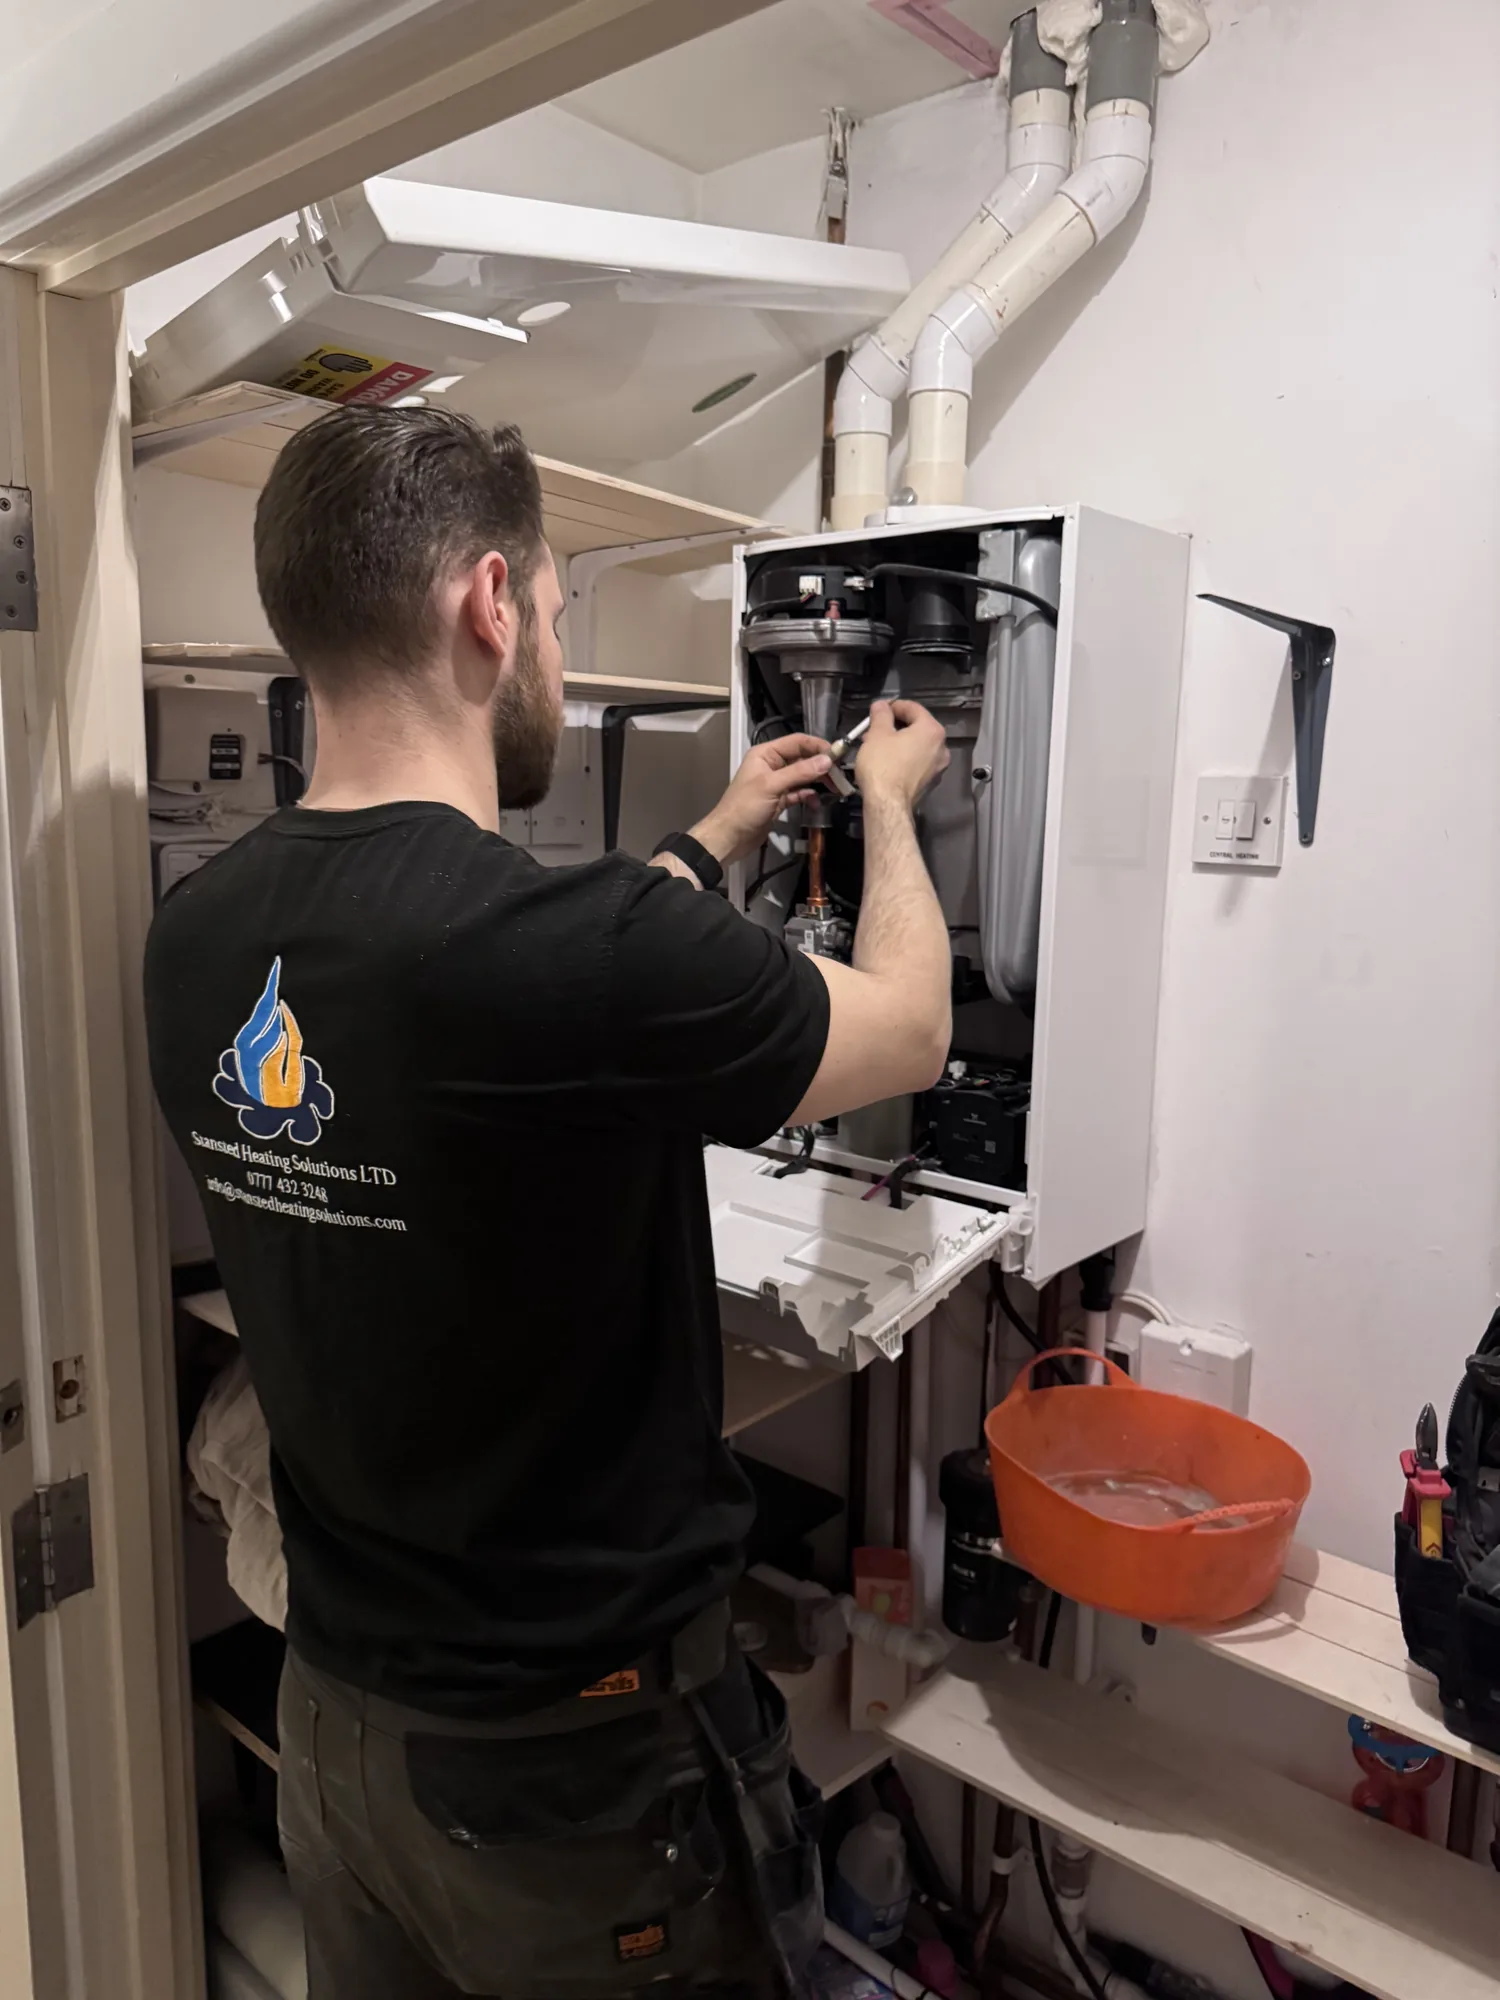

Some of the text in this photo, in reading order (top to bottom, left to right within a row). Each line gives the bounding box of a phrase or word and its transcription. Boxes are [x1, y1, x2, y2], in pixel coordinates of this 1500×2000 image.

[346, 370, 416, 405] DANG
[1235, 852, 1259, 860] HEATING
[242, 1143, 293, 1174] Heating
[291, 1154, 358, 1182] Solutions
[359, 1164, 397, 1186] LTD
[276, 1177, 300, 1196] 432
[300, 1182, 329, 1204] 3248
